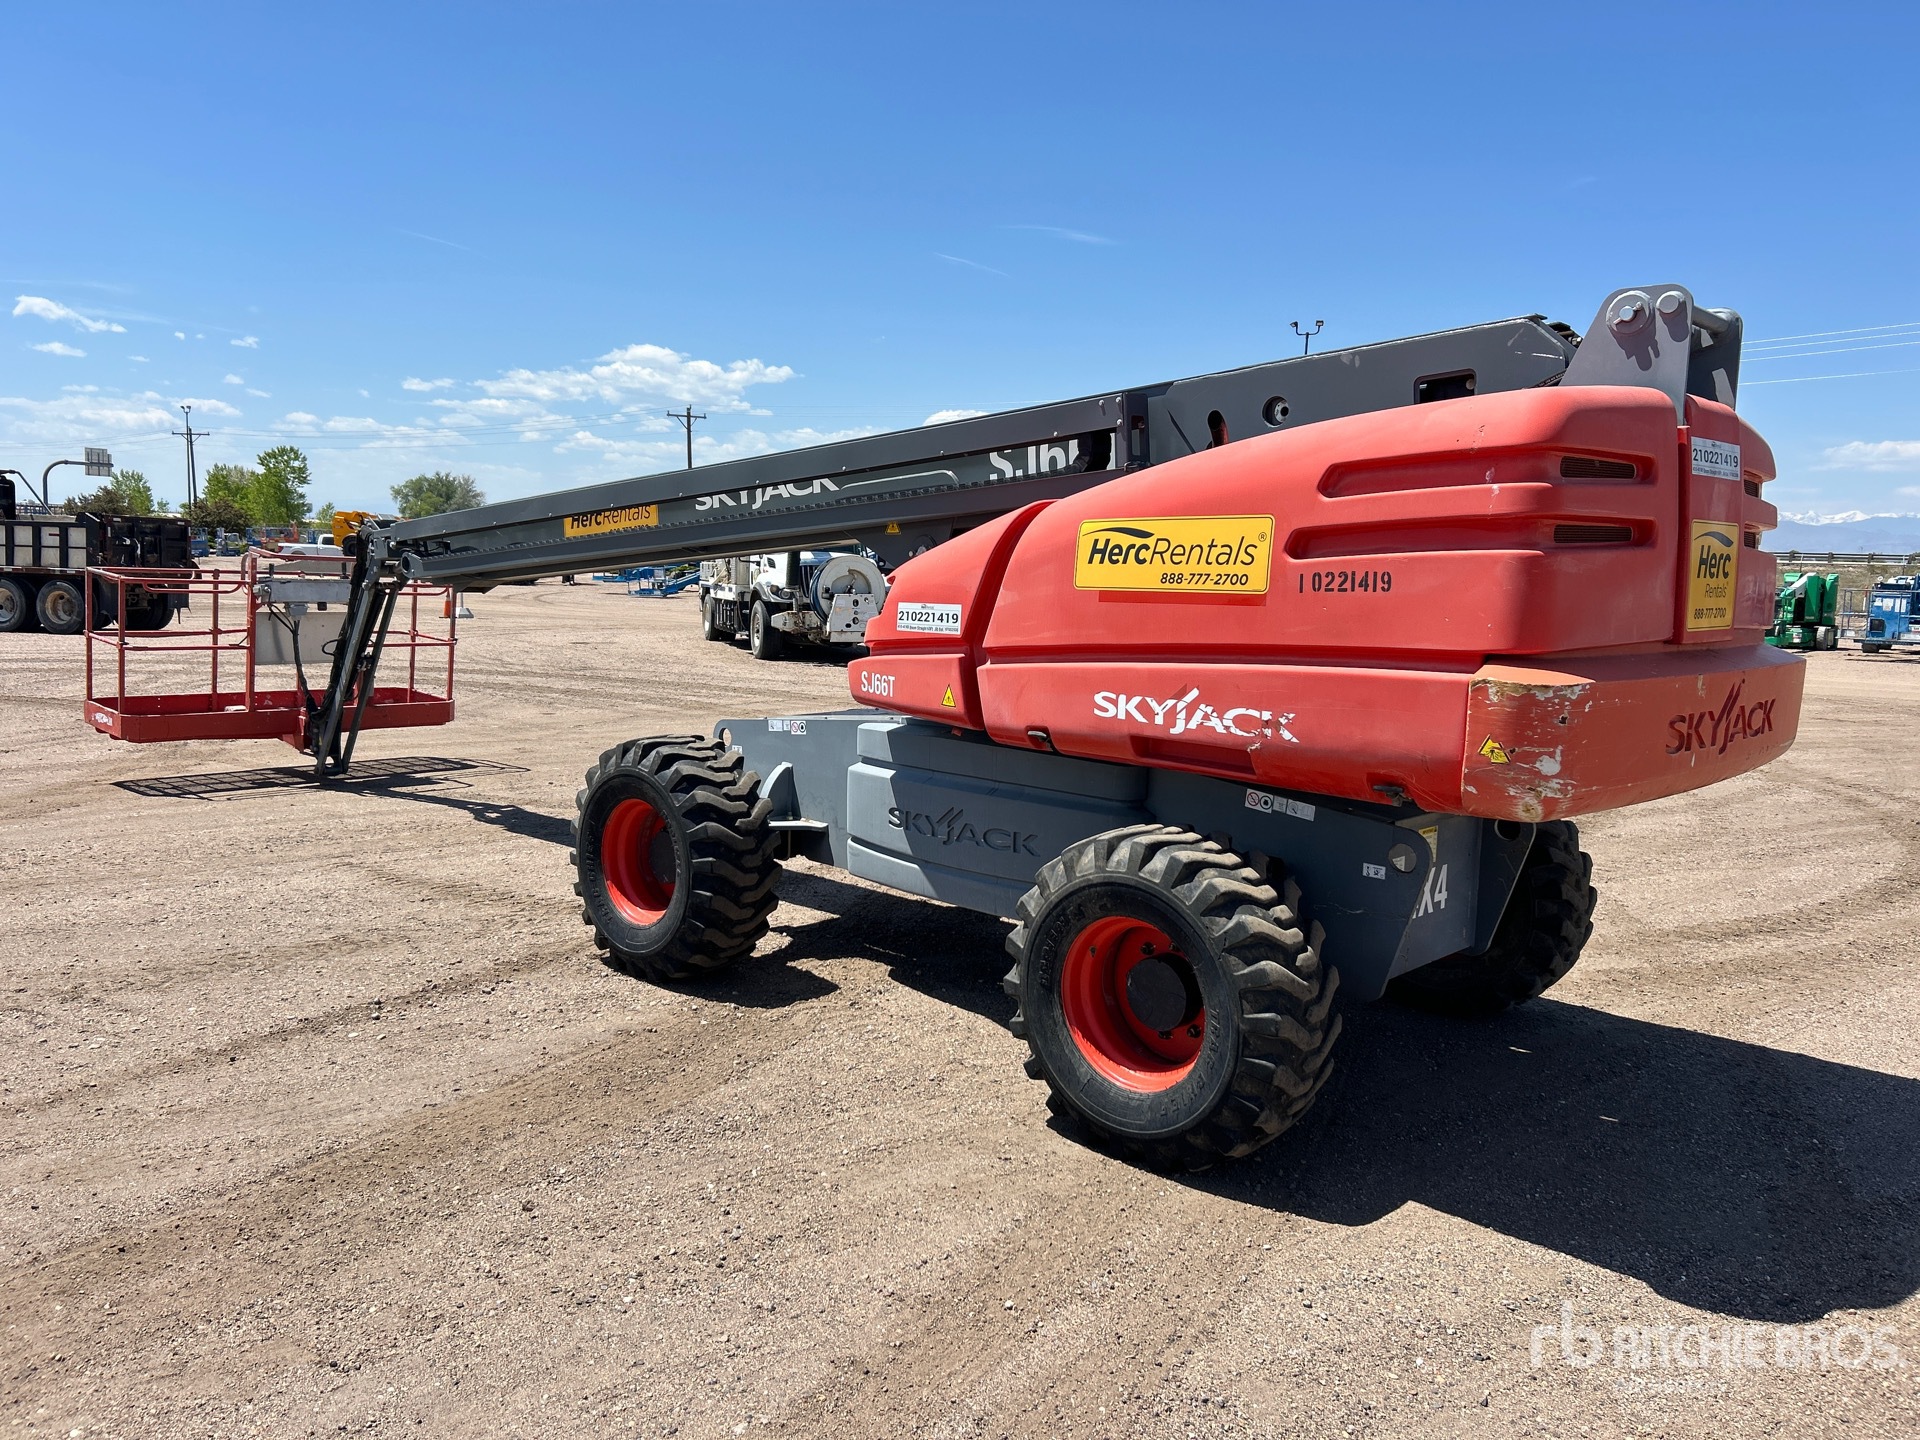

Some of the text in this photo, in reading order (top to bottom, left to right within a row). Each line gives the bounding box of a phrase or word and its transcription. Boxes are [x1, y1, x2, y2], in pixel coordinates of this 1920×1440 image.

[1692, 448, 1739, 468] 210221419
[1696, 544, 1731, 579] Herc
[1160, 572, 1249, 586] 888-777-2700
[898, 610, 959, 625] 210221419
[1693, 607, 1727, 620] 888-777-2700
[861, 670, 896, 698] SJ66T
[1093, 686, 1300, 743] SKYJACK
[1665, 678, 1776, 755] SKYJACK
[888, 806, 1041, 857] SKYJACK
[1412, 863, 1448, 920] X4
